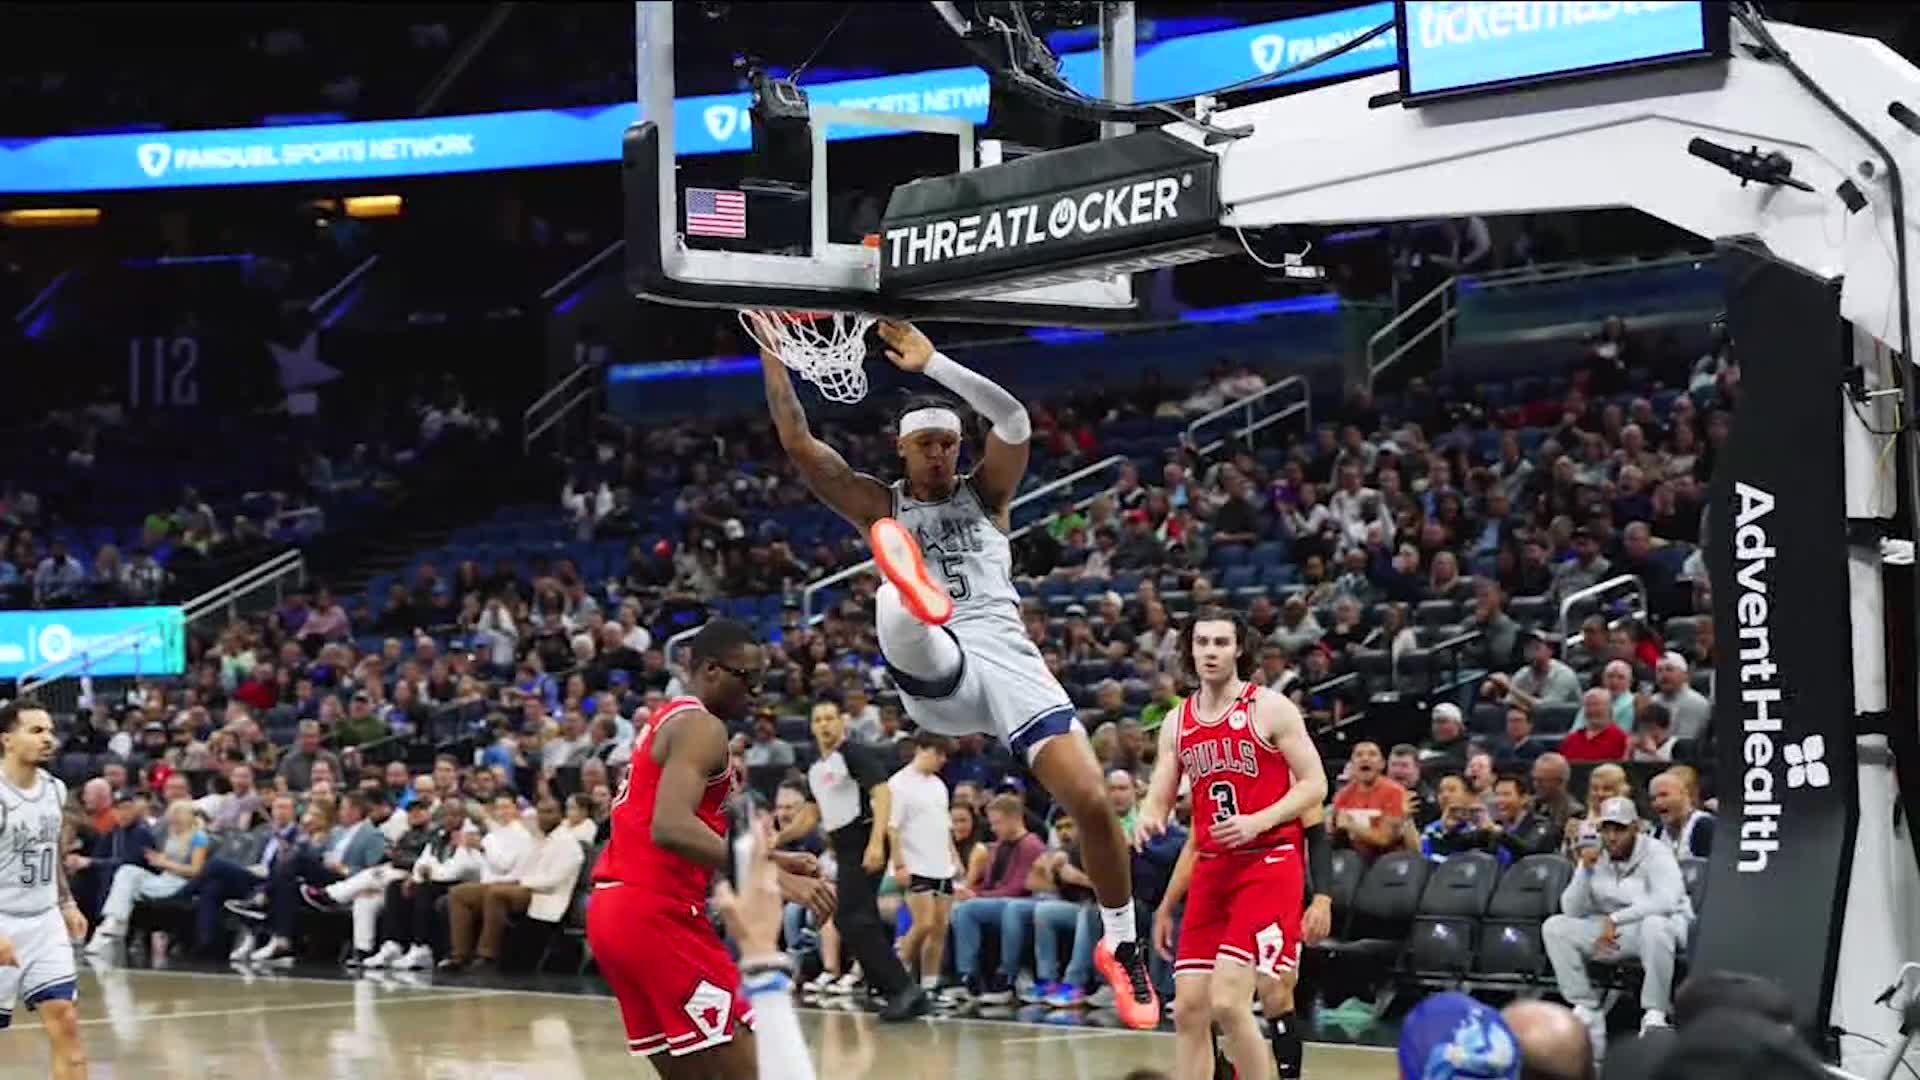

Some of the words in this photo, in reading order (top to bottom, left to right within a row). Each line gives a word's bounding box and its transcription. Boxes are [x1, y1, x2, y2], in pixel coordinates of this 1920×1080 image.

[1418, 1, 1672, 48] ticketmas
[175, 146, 279, 169] FANDUEL
[282, 140, 364, 165] SPORTS
[369, 134, 474, 161] NETWORK
[886, 177, 1181, 268] THREATLOCKER
[129, 336, 198, 407] 112
[939, 554, 971, 601] 5
[1735, 481, 1782, 872] AdventHealth
[1182, 737, 1259, 786] BULLS
[1209, 781, 1240, 823] 3
[20, 847, 54, 888] 50
